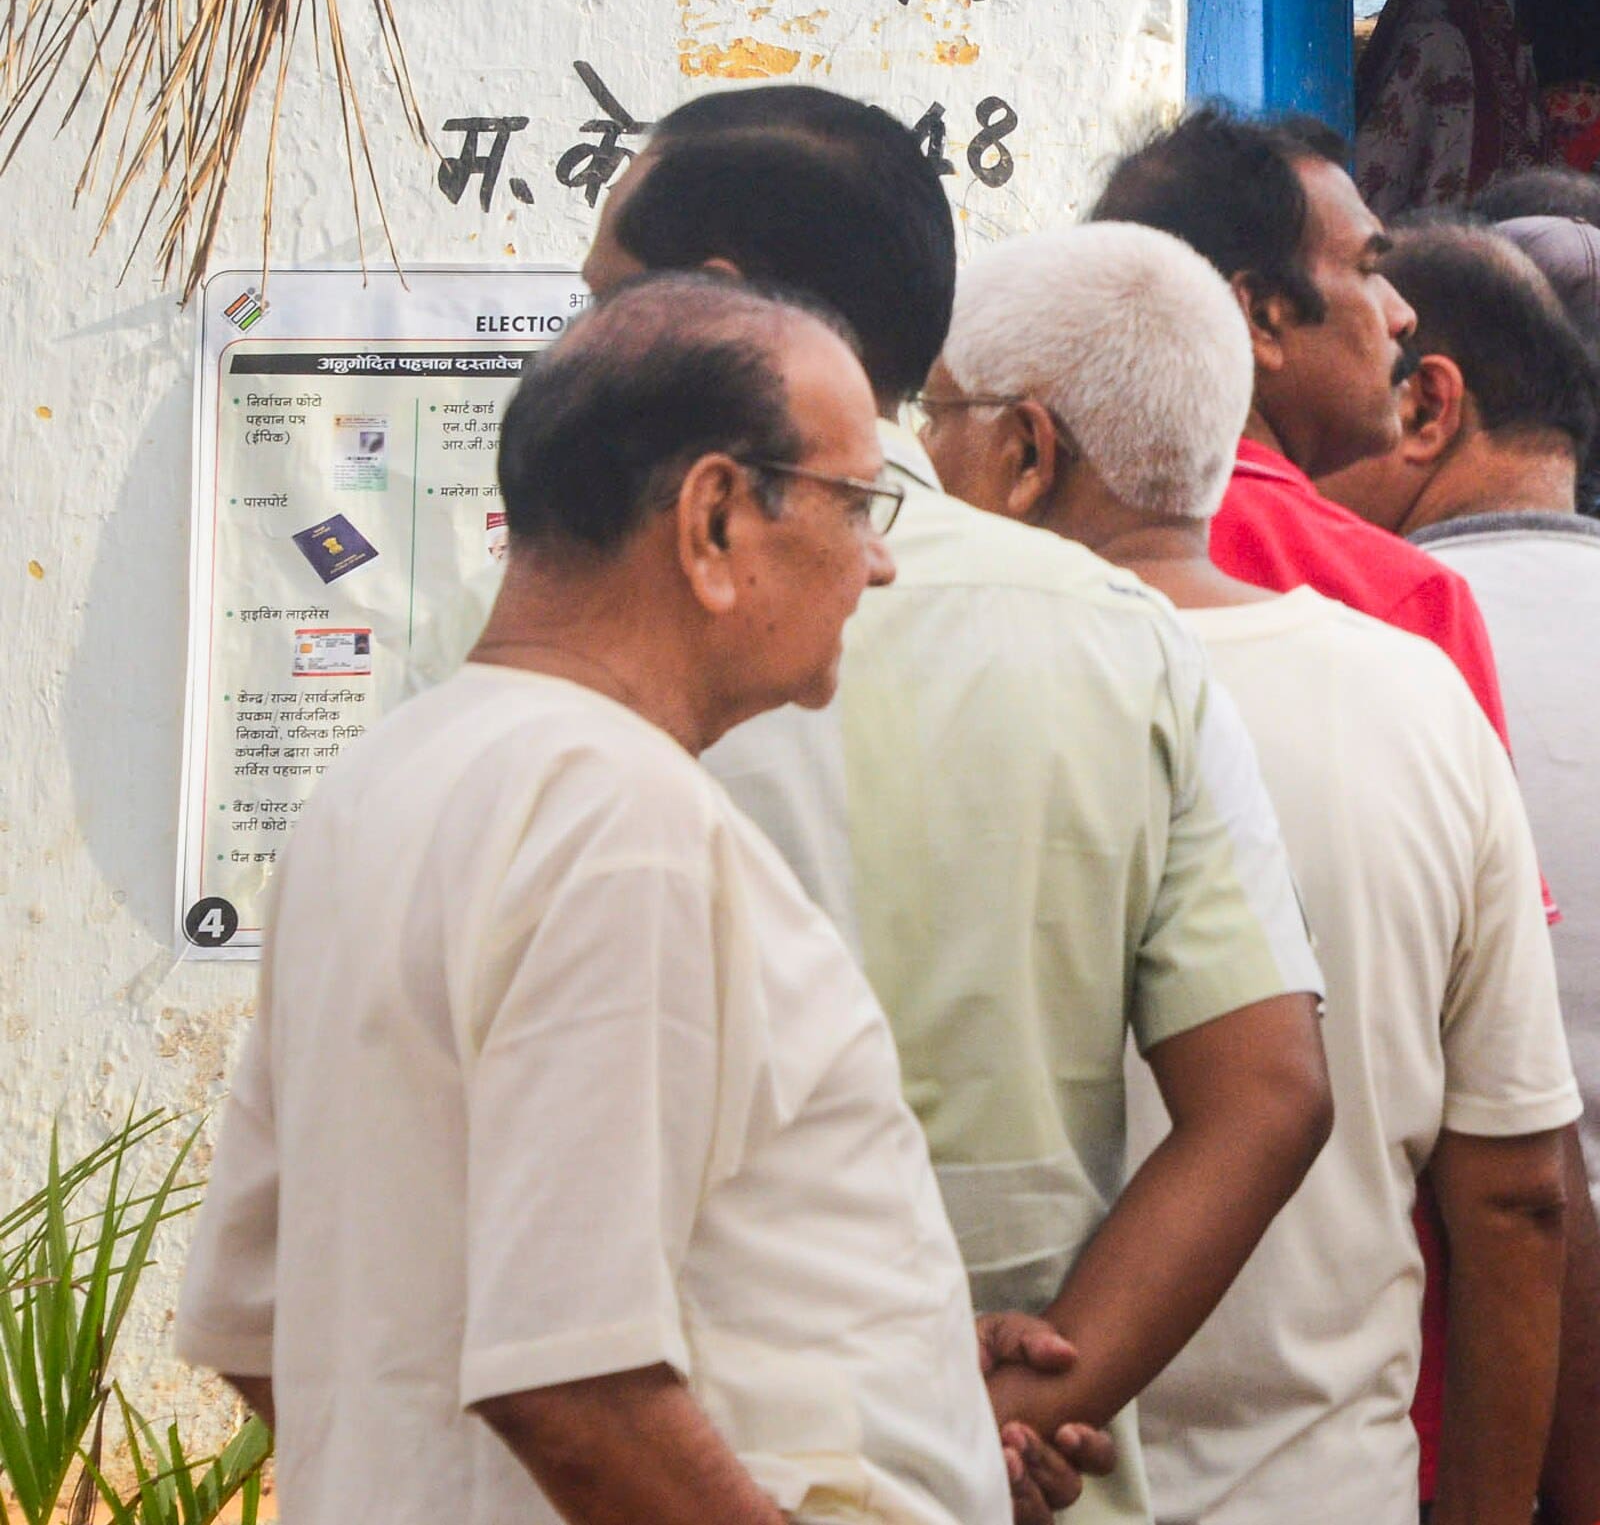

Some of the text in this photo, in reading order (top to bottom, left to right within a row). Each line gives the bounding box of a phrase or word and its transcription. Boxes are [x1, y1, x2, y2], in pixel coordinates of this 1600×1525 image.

[317, 354, 523, 374] अनुमोदित पहचान दस्तावेज
[246, 392, 323, 407] निर्वाचन फोटो
[472, 400, 495, 415] कार्ड
[246, 414, 306, 427] पहचान पत्र
[244, 428, 291, 445] (ईपिक)
[440, 483, 479, 497] मनरेगा
[243, 491, 289, 508] पासपोर्ट
[287, 724, 329, 740] पब्लिक
[283, 747, 309, 758] द्वारा
[313, 742, 340, 758] जारी
[272, 764, 312, 777] पहचान
[231, 817, 258, 832] जारी
[261, 816, 287, 831] फोटो
[231, 849, 250, 863] पैन
[197, 907, 226, 939] 4
